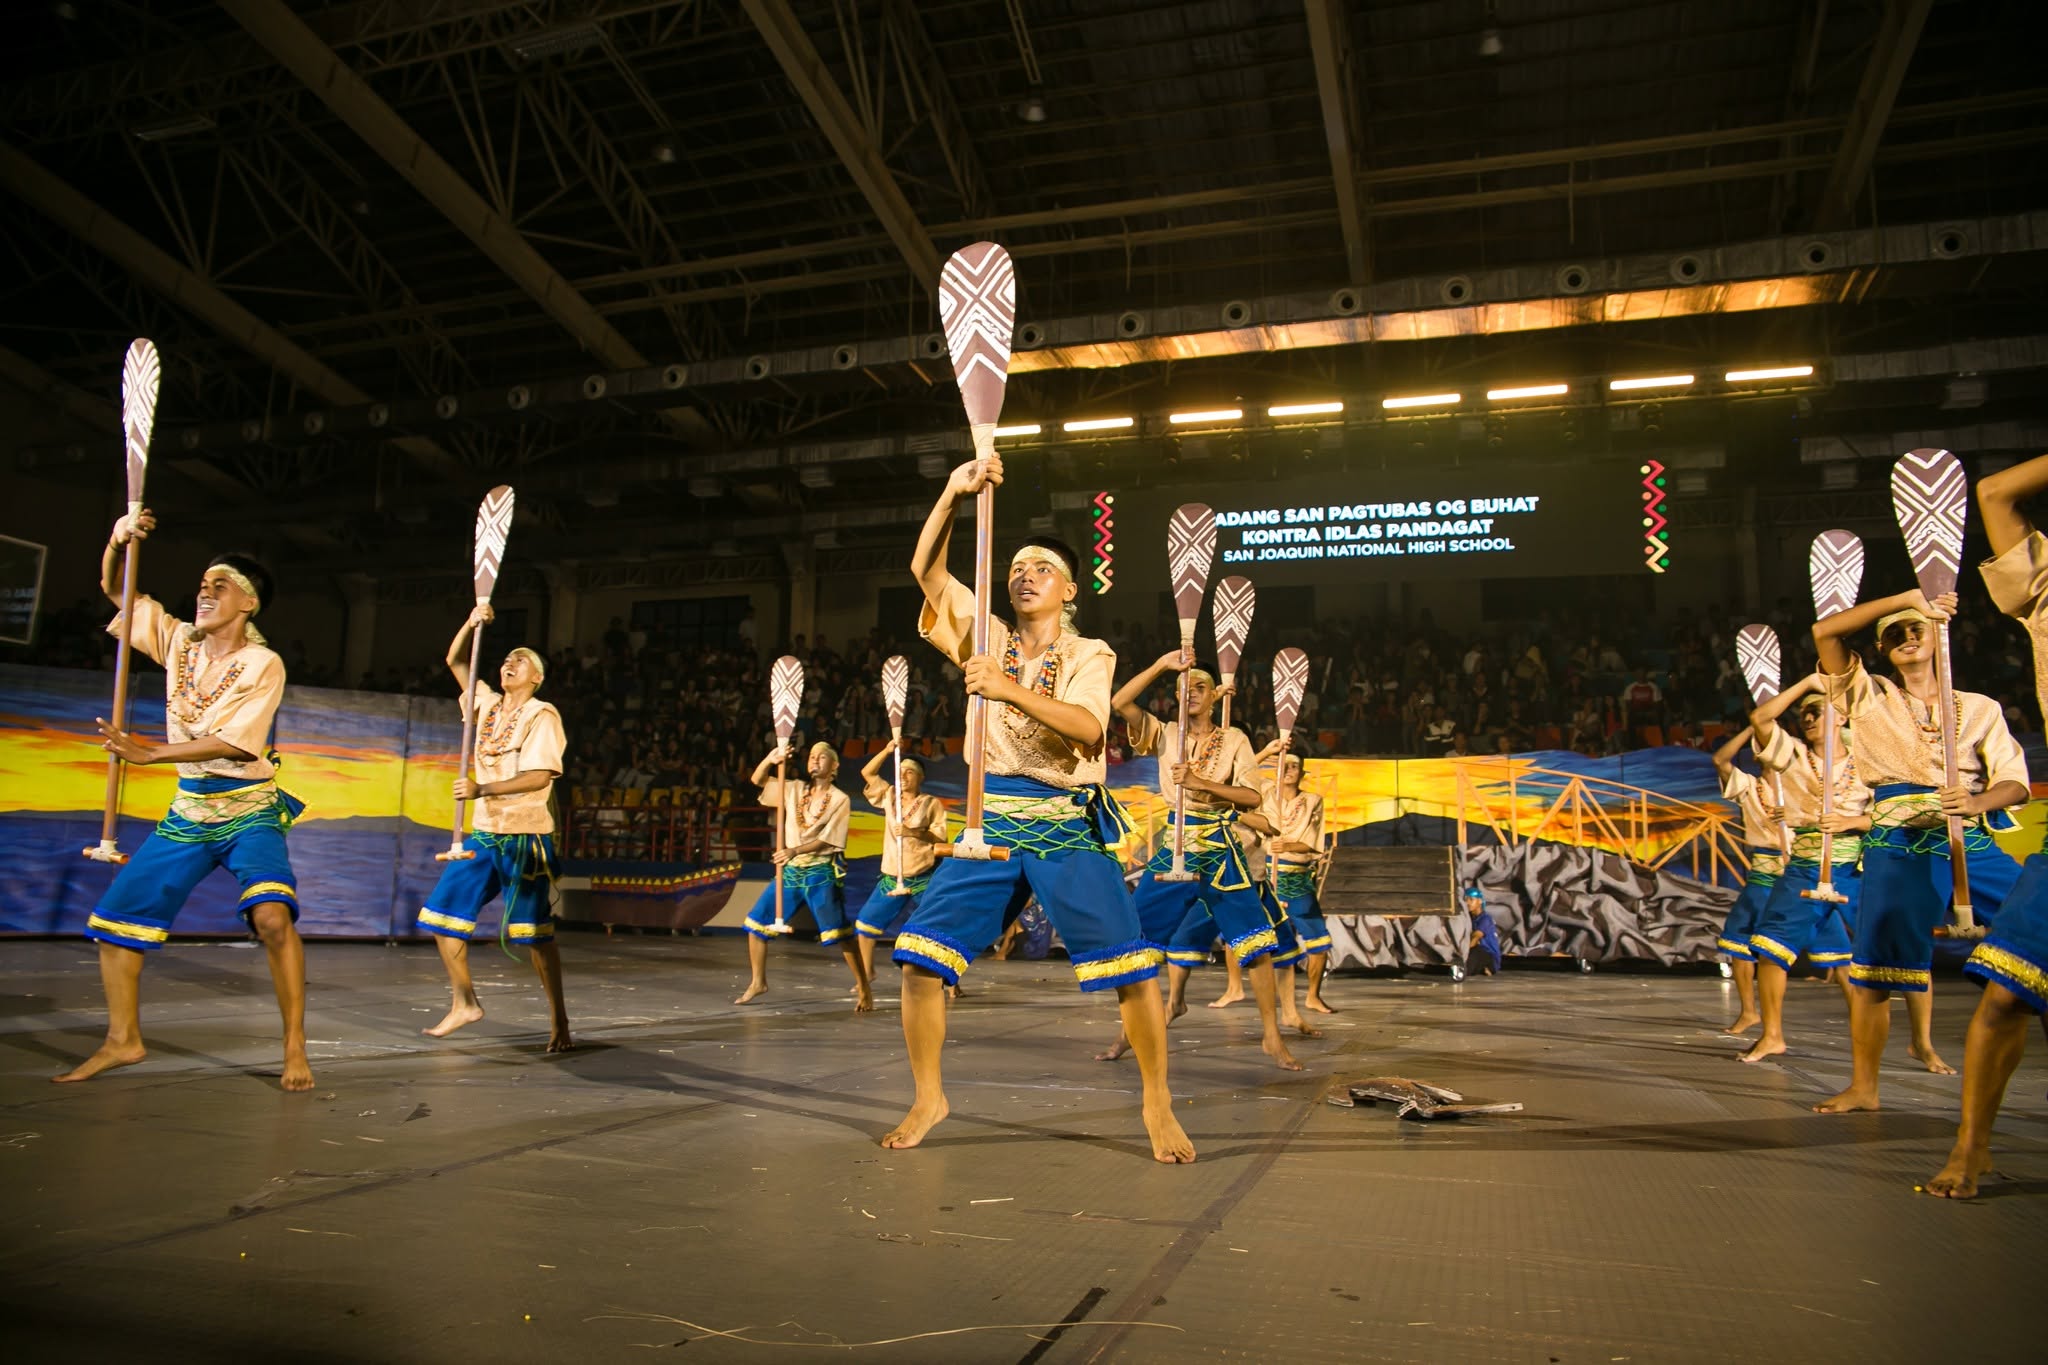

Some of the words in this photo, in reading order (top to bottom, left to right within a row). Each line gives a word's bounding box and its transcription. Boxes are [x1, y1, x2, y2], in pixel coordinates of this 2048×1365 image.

[1284, 507, 1325, 524] SAN
[1327, 502, 1432, 522] PAGTUBAS
[1435, 499, 1467, 516] OG
[1470, 496, 1540, 515] BUHAT
[1241, 526, 1322, 546] KONTRA
[1324, 523, 1383, 542] IDLAS
[1386, 518, 1495, 539] PANDAGAT
[1223, 549, 1254, 563] SAN
[1256, 545, 1324, 562] JOAQUIN
[1326, 542, 1405, 558] NATIONAL
[1407, 540, 1447, 554] HIGH
[1448, 537, 1516, 553] SCHOOL
